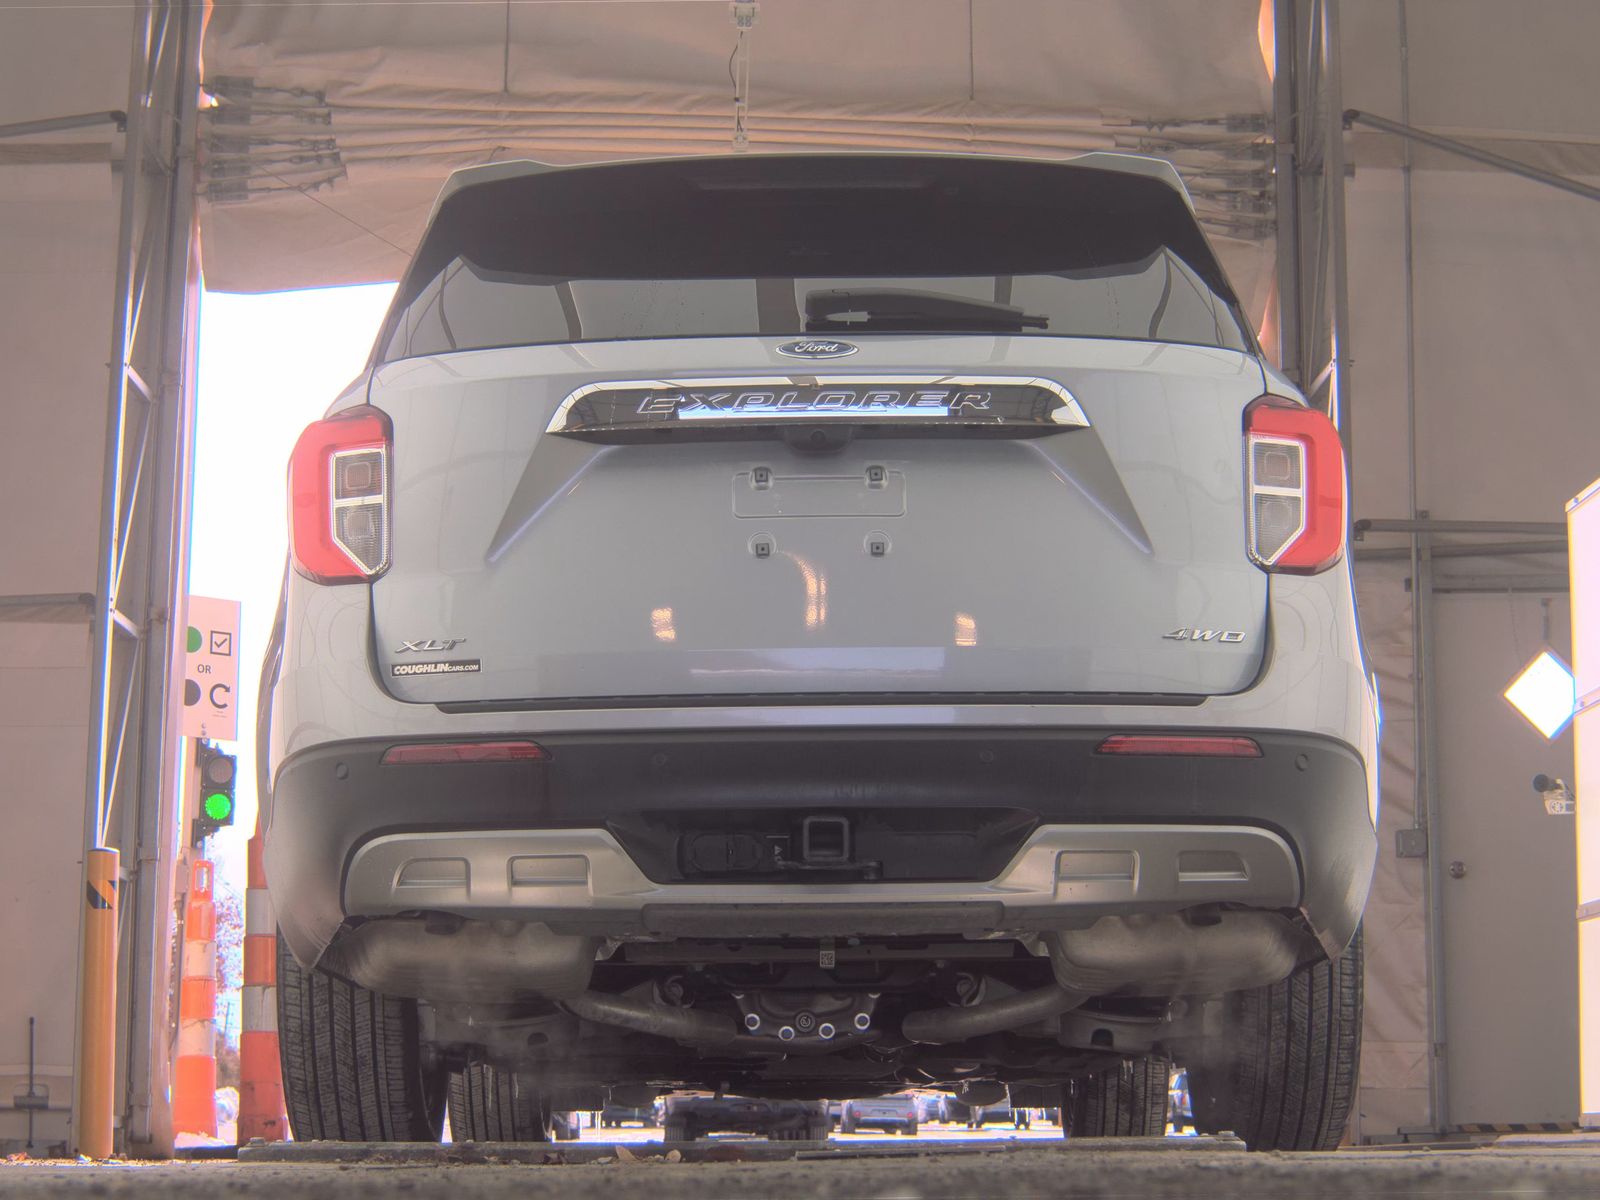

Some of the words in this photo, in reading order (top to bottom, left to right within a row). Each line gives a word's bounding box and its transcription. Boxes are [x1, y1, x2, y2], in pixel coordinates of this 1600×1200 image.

[795, 342, 838, 353] Ford
[637, 391, 992, 414] EXPLORER
[1162, 628, 1245, 642] 4WD
[395, 638, 466, 653] XLT
[197, 663, 212, 674] OR
